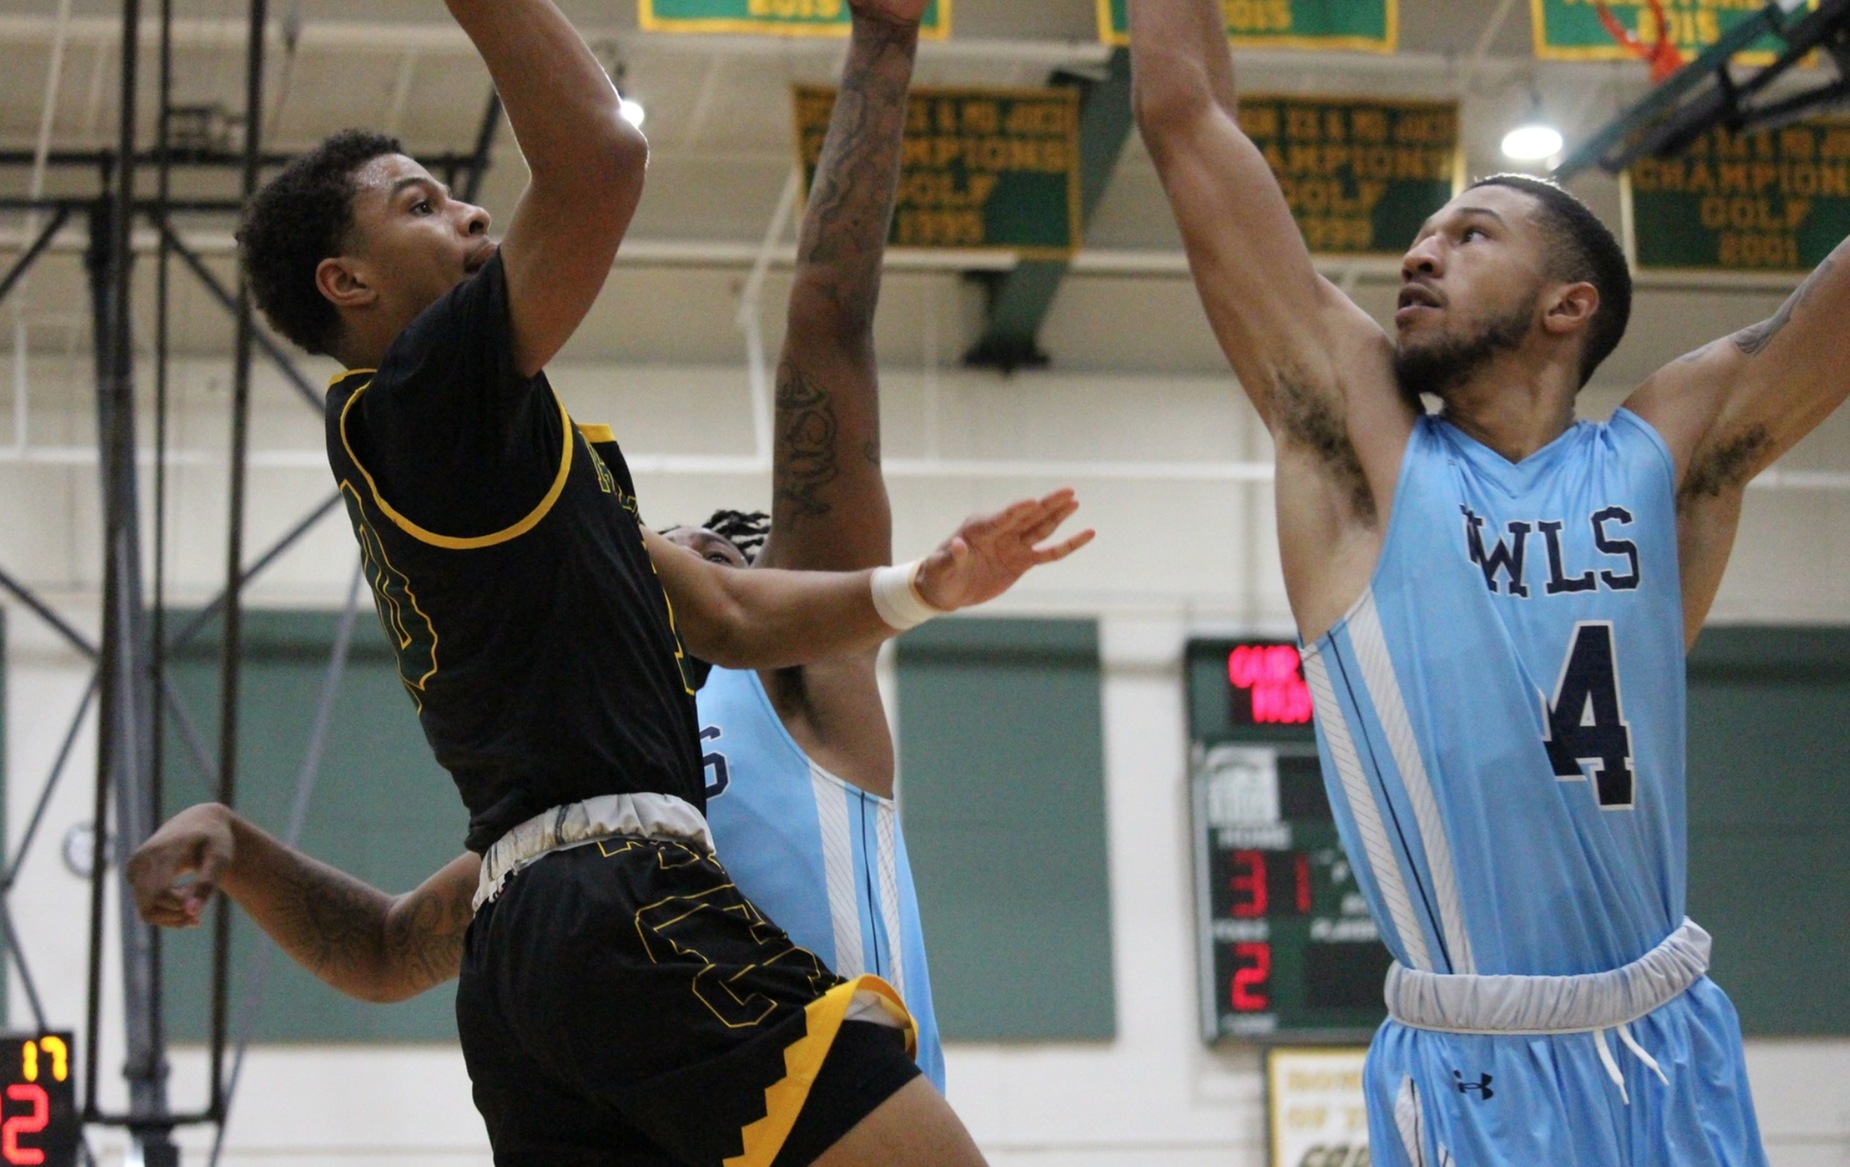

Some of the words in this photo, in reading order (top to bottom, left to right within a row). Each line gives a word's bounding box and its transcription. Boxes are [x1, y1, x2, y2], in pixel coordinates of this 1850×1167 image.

[805, 131, 1068, 173] CMPIONS
[1258, 147, 1452, 180] AMPIONS
[1701, 196, 1810, 230] GOLF
[1459, 503, 1641, 598] WLS
[1538, 619, 1635, 811] 4
[1231, 940, 1271, 1011] 2
[22, 1035, 68, 1082] 17
[0, 1083, 49, 1166] 2
